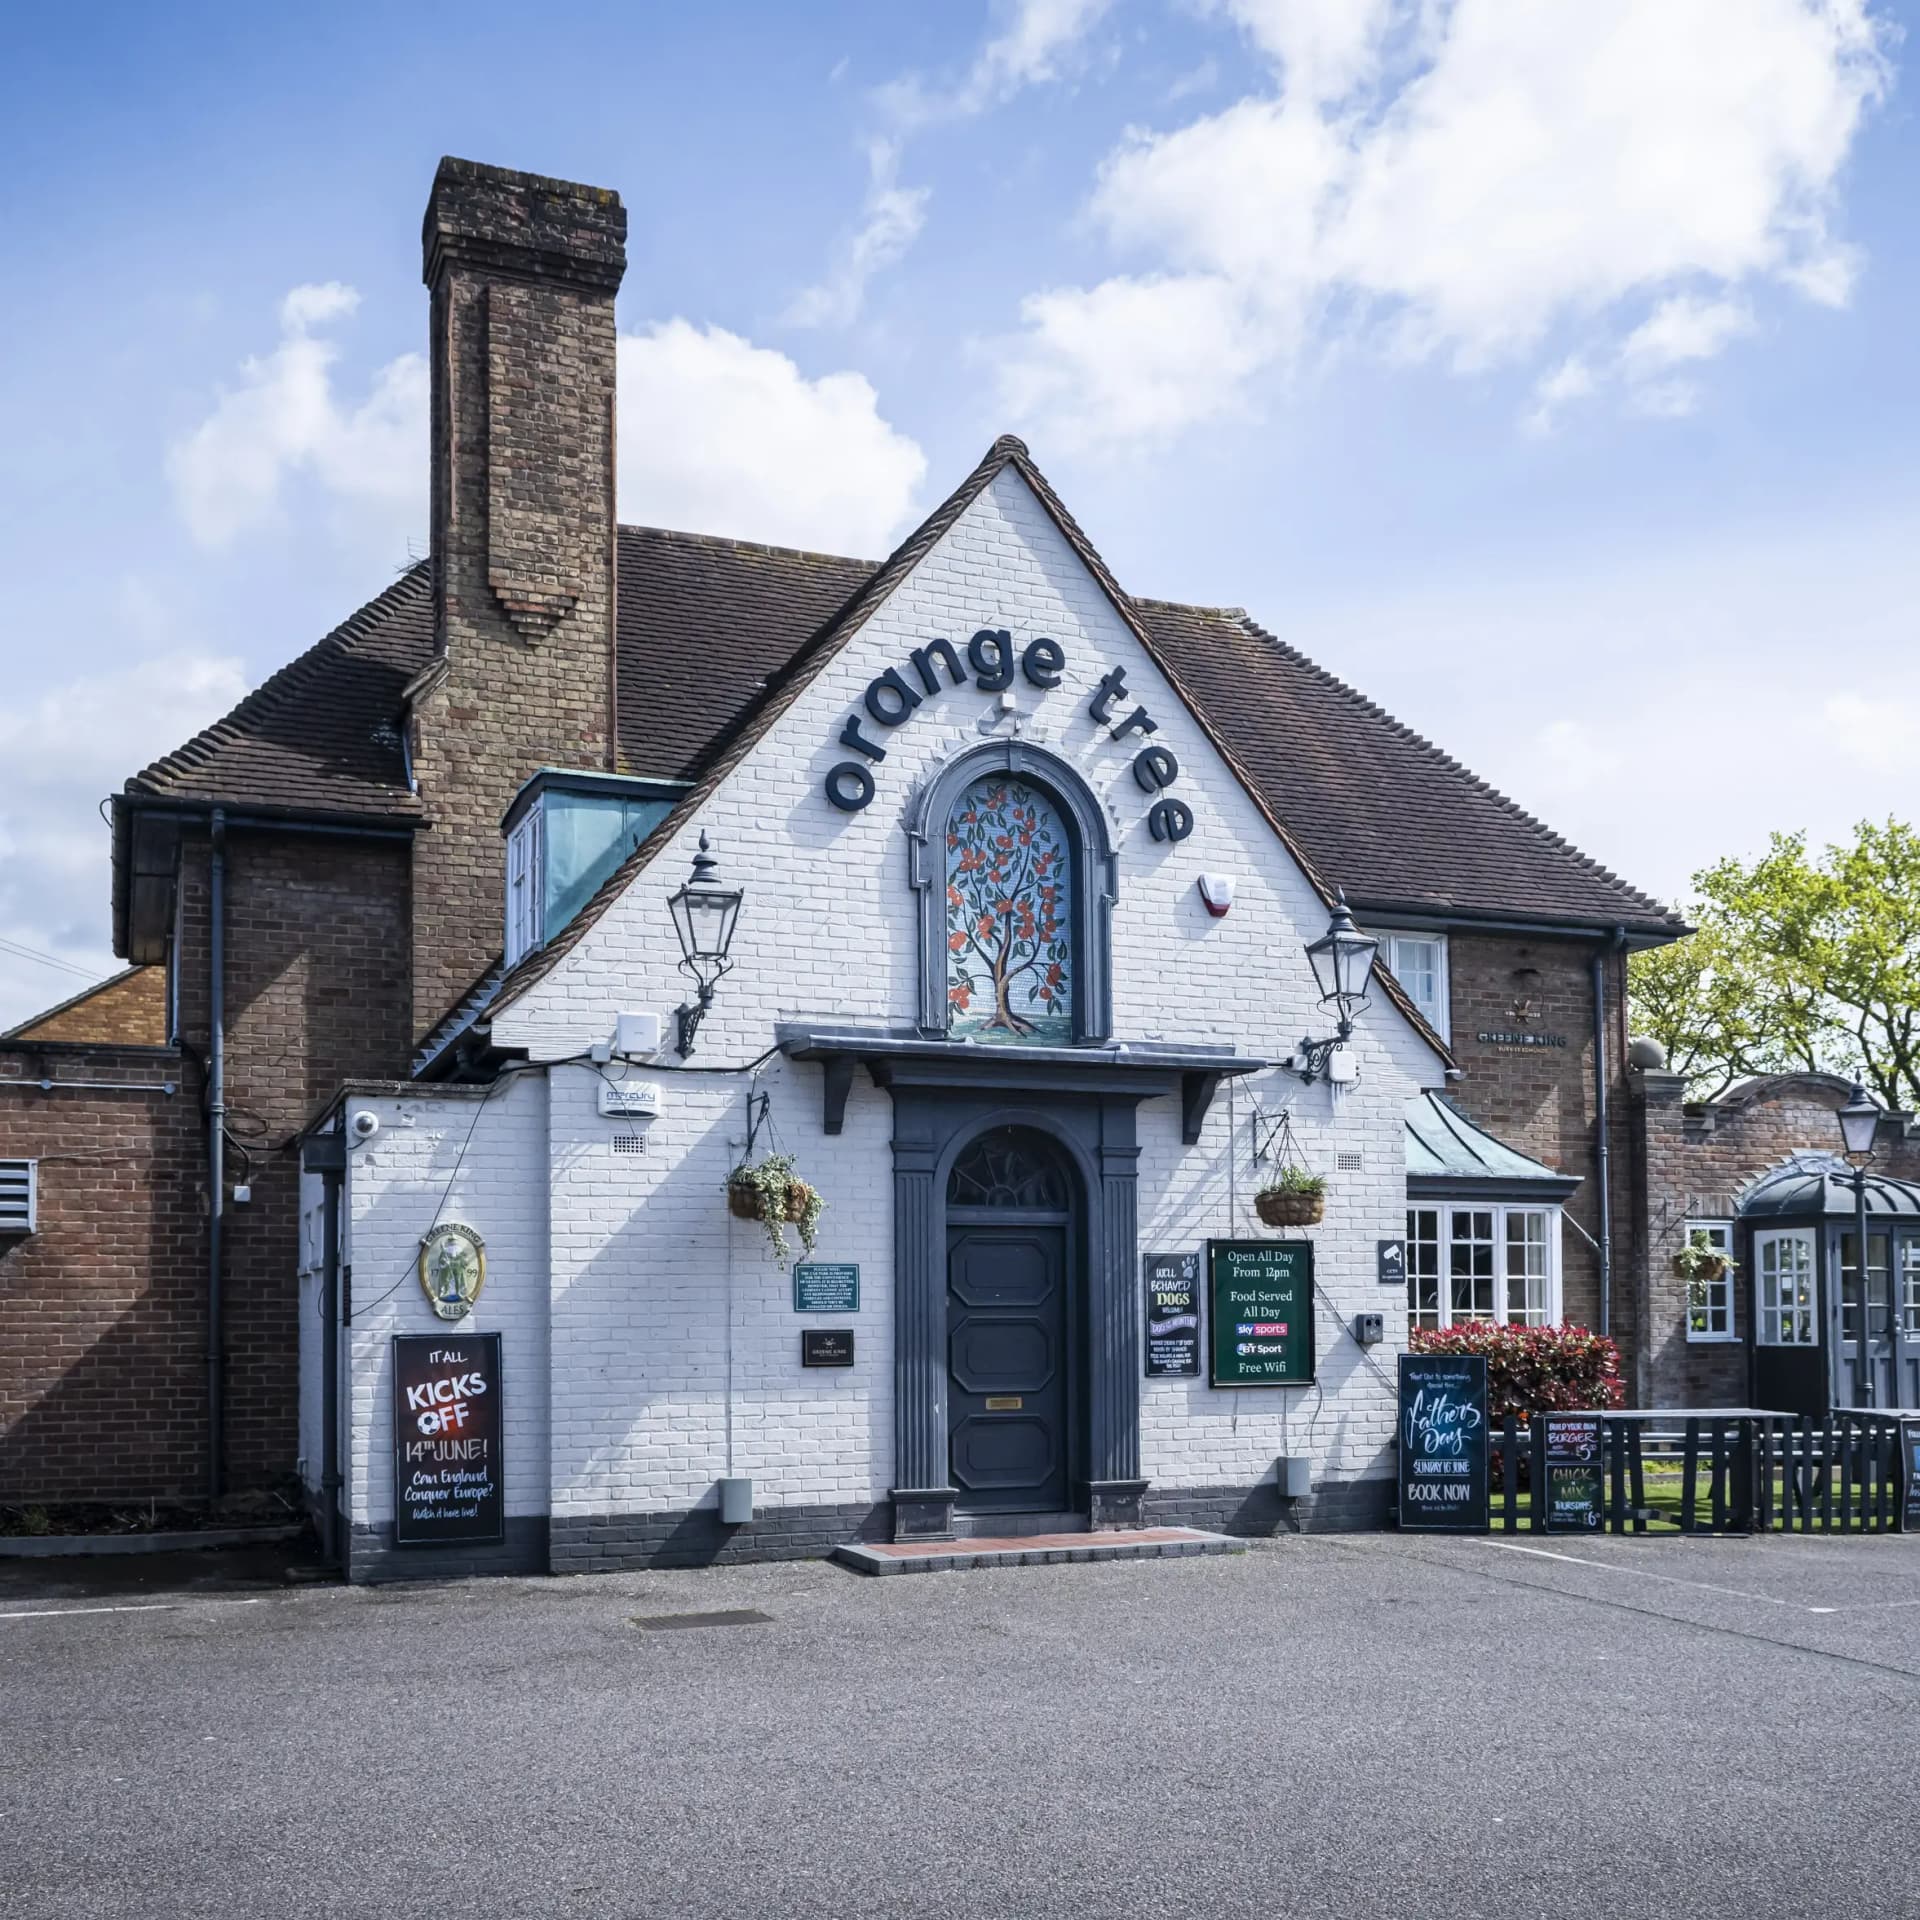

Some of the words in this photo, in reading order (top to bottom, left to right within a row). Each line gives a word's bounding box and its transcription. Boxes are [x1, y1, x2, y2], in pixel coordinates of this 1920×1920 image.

[825, 629, 1065, 811] orange
[1088, 665, 1194, 842] tree
[1535, 1034, 1567, 1048] KING
[426, 1223, 458, 1242] GREENE
[460, 1225, 482, 1243] KING
[1227, 1251, 1255, 1264] Open
[1257, 1250, 1272, 1262] All
[1275, 1251, 1294, 1264] Day
[431, 1268, 439, 1277] 17
[466, 1268, 478, 1278] 99
[1156, 1267, 1176, 1279] WELL
[1233, 1266, 1260, 1278] From
[1266, 1266, 1290, 1281] 12pm
[1151, 1280, 1190, 1292] BEHAVED
[1157, 1292, 1190, 1306] DOGS
[1230, 1290, 1256, 1302] Food
[1258, 1290, 1293, 1302] Served
[441, 1304, 464, 1315] ALES
[1243, 1306, 1258, 1318] All
[1260, 1306, 1281, 1319] Day
[1238, 1324, 1254, 1334] sky
[1255, 1324, 1286, 1334] sports
[1242, 1343, 1256, 1354] BT
[1257, 1344, 1282, 1355] Sport
[429, 1350, 442, 1364] IT
[442, 1351, 468, 1363] ALL
[1238, 1362, 1262, 1374] Free
[1264, 1361, 1287, 1373] Wifi
[406, 1372, 487, 1411] KICKS
[417, 1402, 470, 1436] OFF
[1419, 1427, 1472, 1455] Day
[1547, 1432, 1599, 1444] BURGER
[406, 1440, 435, 1463] 14TH
[433, 1438, 488, 1462] JUNE!
[1413, 1461, 1442, 1474] SUNDAY
[1443, 1461, 1452, 1473] 16
[1452, 1461, 1470, 1473] JUNE
[1553, 1467, 1592, 1481] CHICK
[413, 1470, 438, 1486] Can
[441, 1464, 488, 1486] England
[404, 1485, 451, 1505] Conquer
[454, 1483, 494, 1503] Europe?
[1408, 1483, 1442, 1501] BOOK
[1443, 1483, 1470, 1501] NOW
[1561, 1486, 1587, 1499] MIX
[412, 1506, 436, 1520] Watch
[436, 1506, 442, 1518] it
[443, 1507, 460, 1518] here
[461, 1503, 479, 1518] live!
